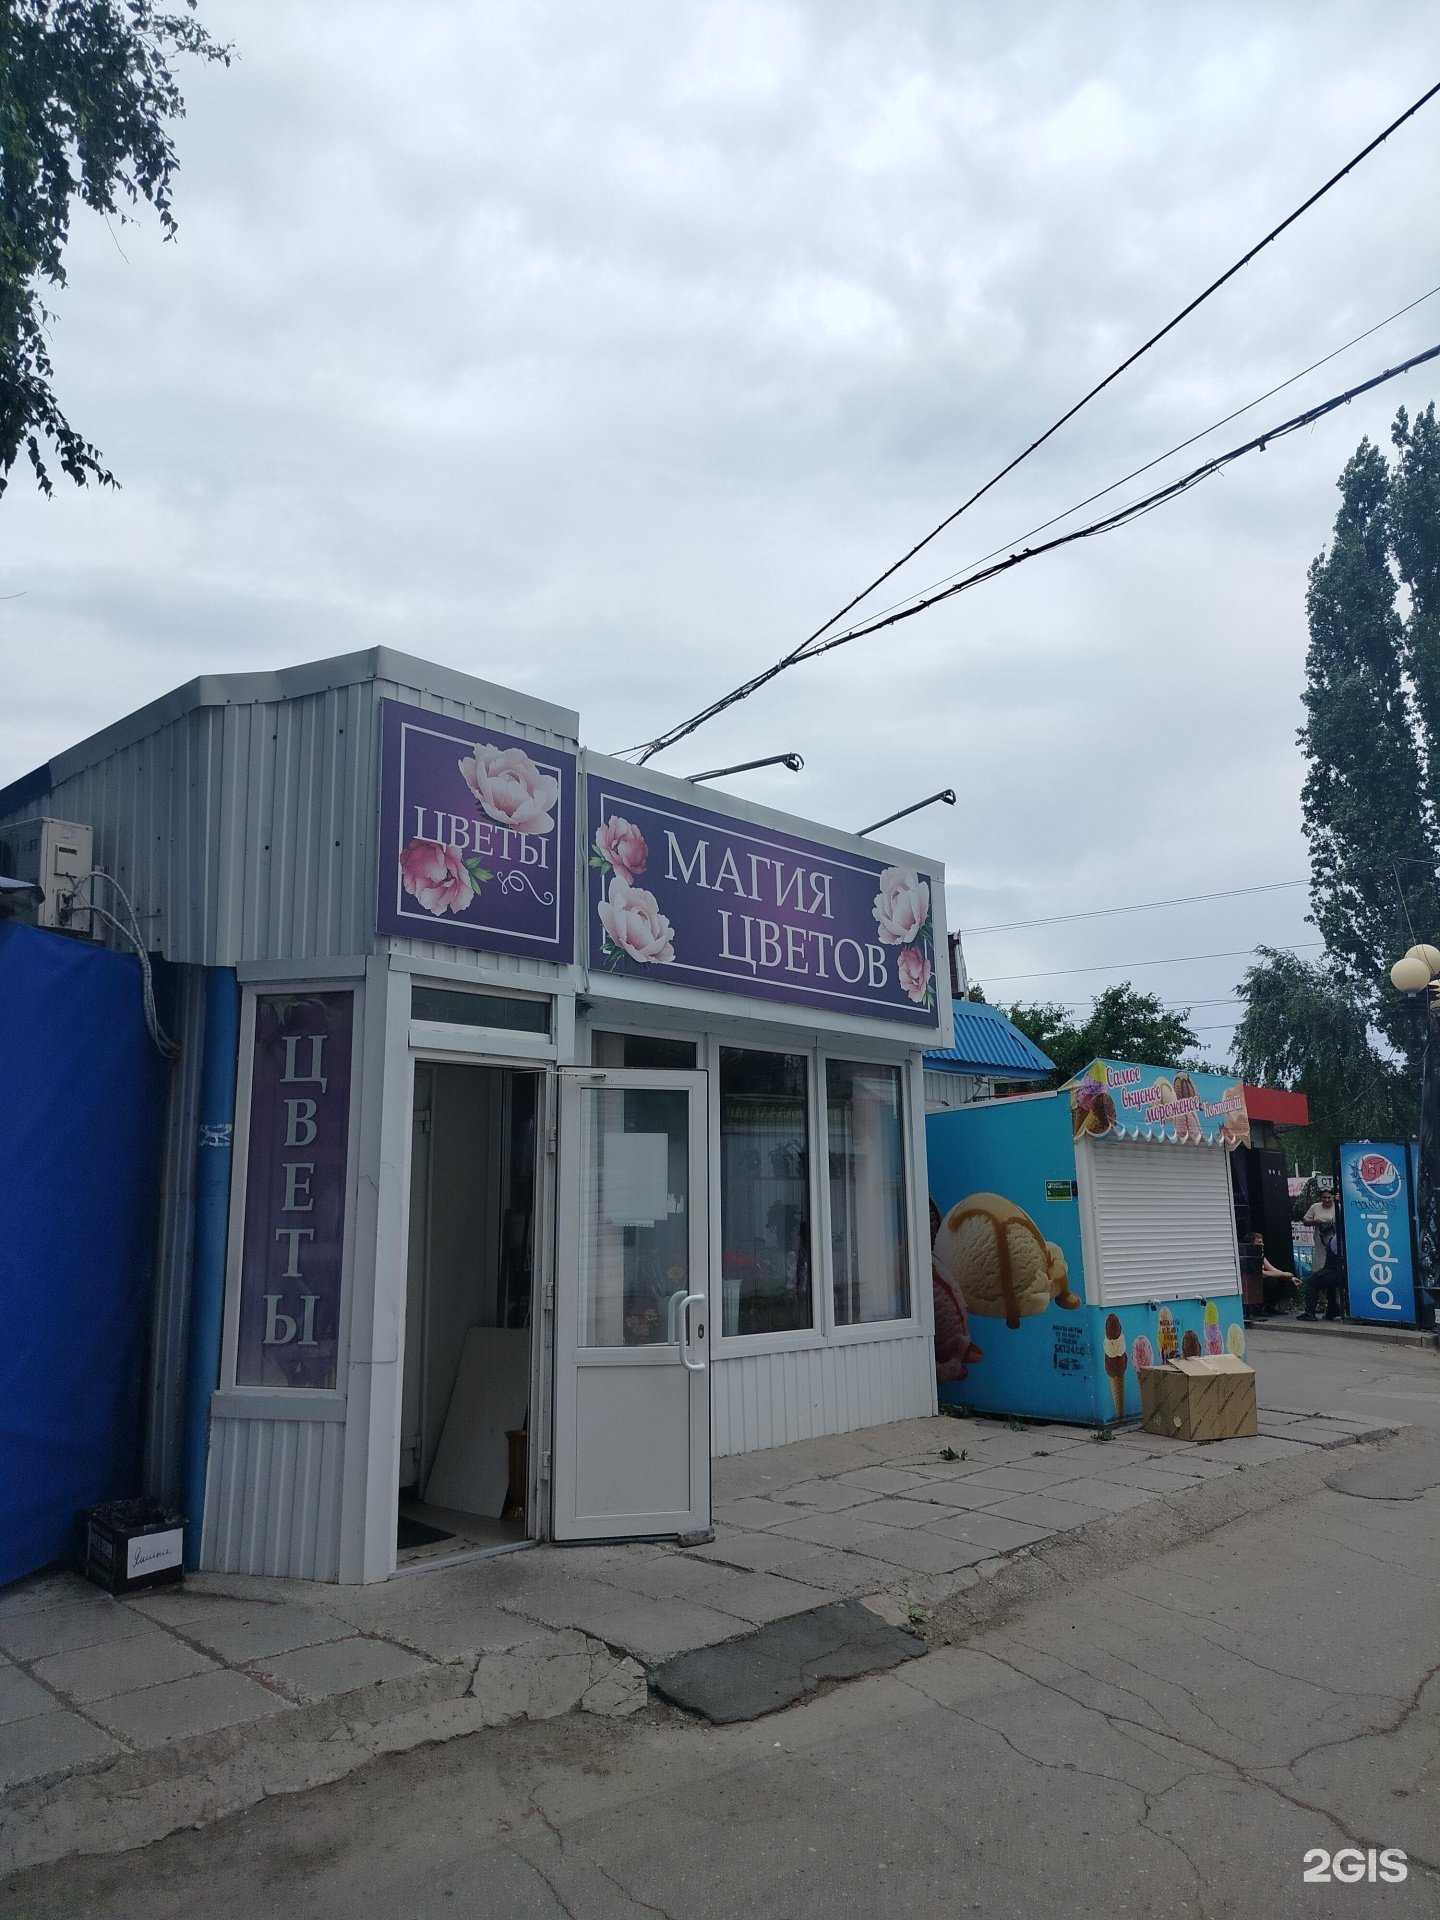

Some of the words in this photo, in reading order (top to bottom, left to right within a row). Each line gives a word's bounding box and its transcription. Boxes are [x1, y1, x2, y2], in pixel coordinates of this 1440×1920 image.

[413, 805, 550, 869] ЦВЕТЫ
[663, 829, 833, 919] МАГИЯ
[717, 909, 889, 989] ЦВЕТОВ
[1106, 1065, 1142, 1088] Самое
[262, 1034, 328, 1346] ЦВЕТЫ
[1360, 1211, 1402, 1310] pepsi
